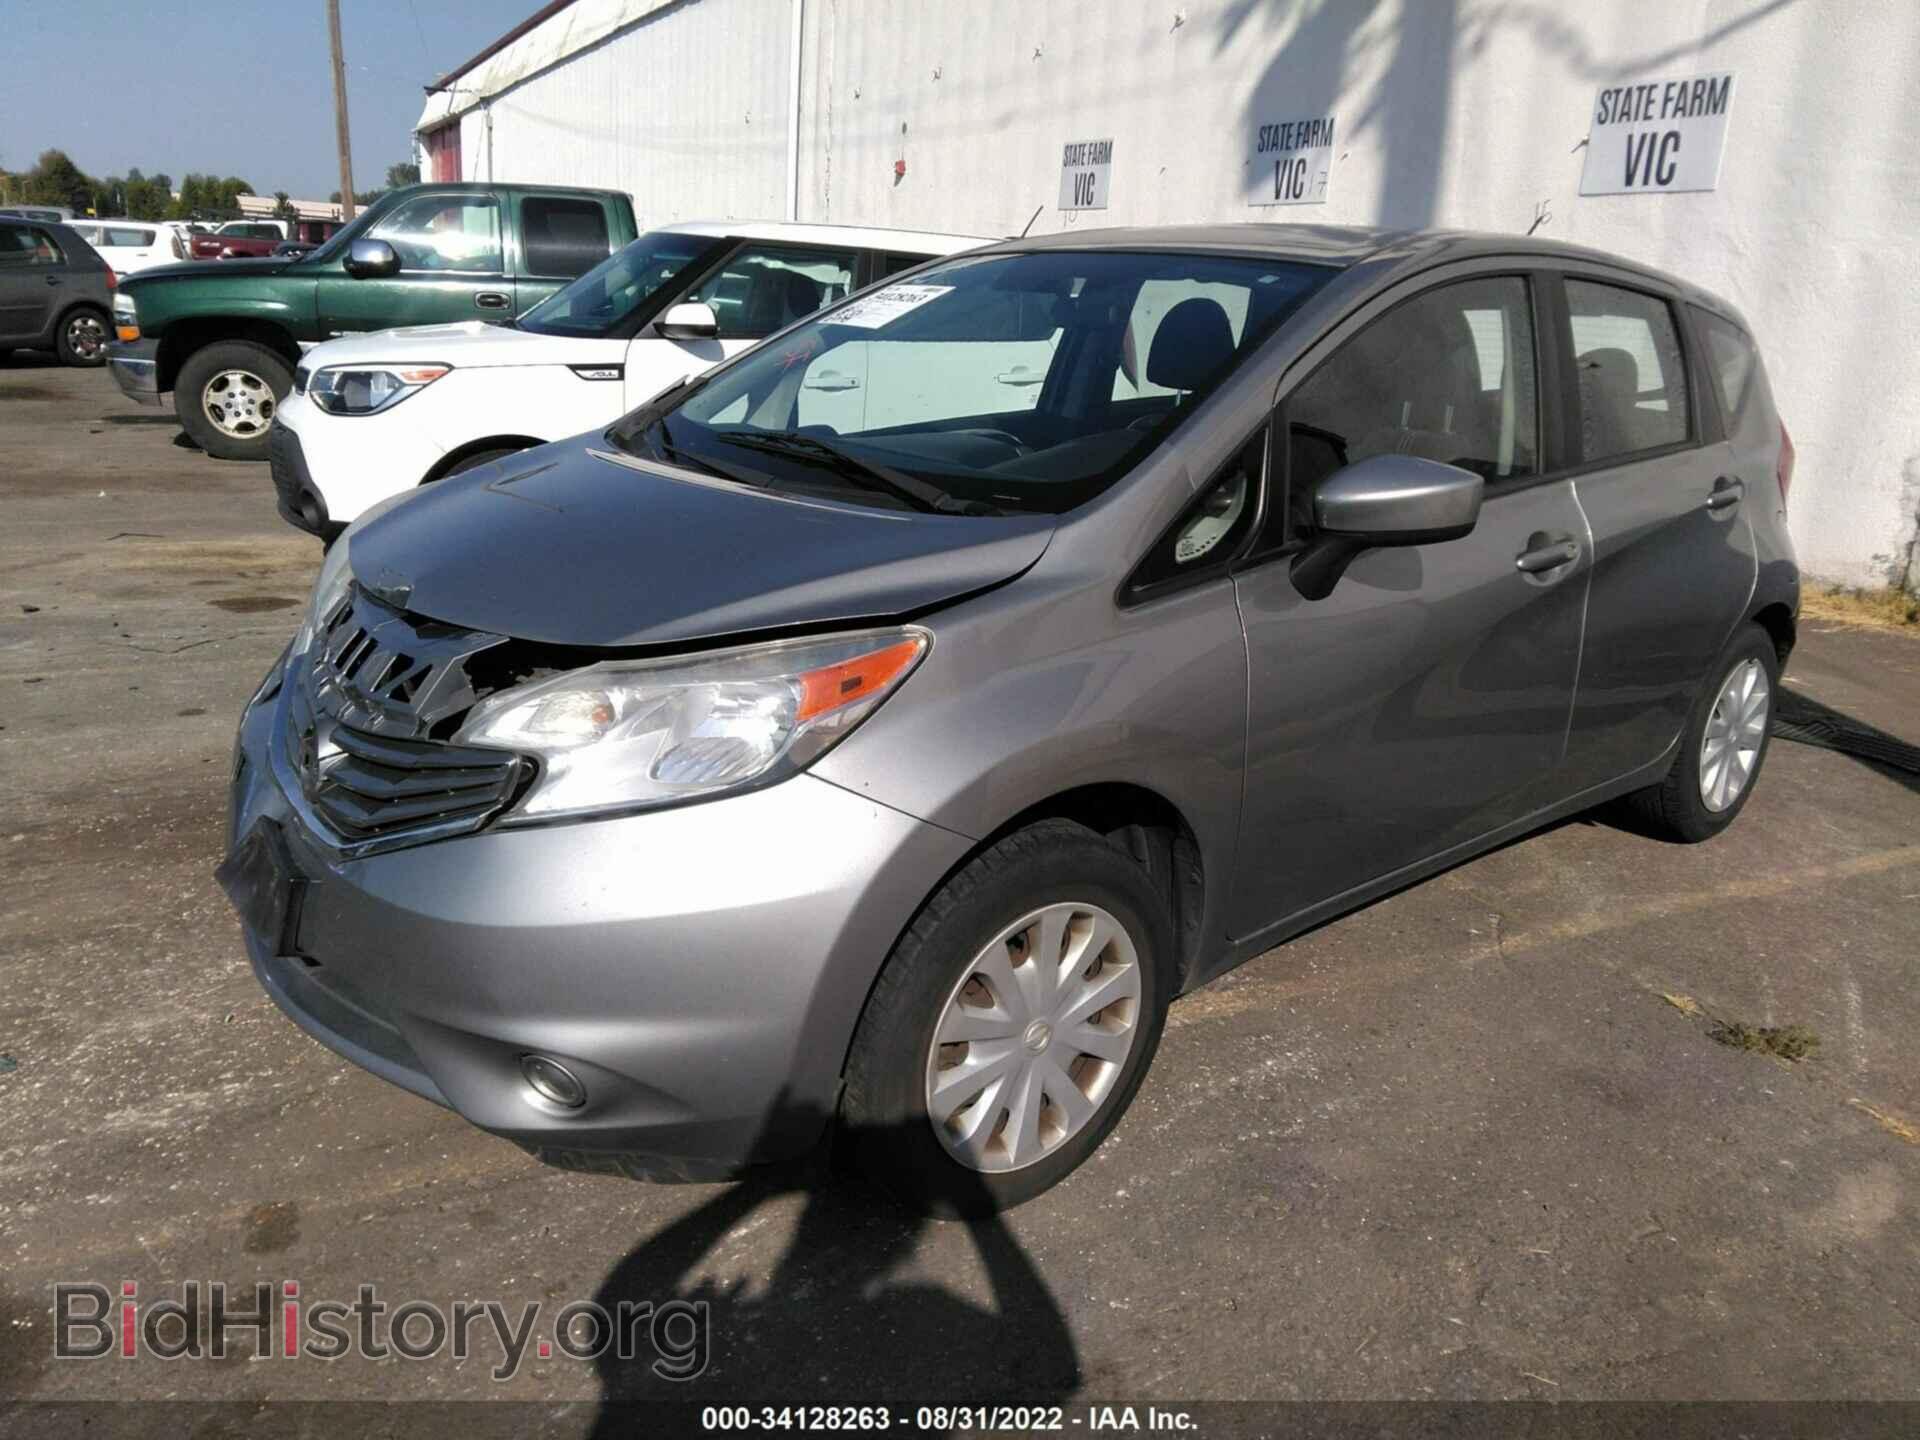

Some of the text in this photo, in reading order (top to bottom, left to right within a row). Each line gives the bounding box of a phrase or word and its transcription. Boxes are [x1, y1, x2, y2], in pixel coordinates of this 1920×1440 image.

[1597, 75, 1731, 125] STATE FARM
[1063, 141, 1113, 168] STATE FARM
[1257, 118, 1335, 153] STATE FARM
[1274, 157, 1307, 200] VIC
[1624, 131, 1681, 187] VIC
[1074, 171, 1096, 206] VIC
